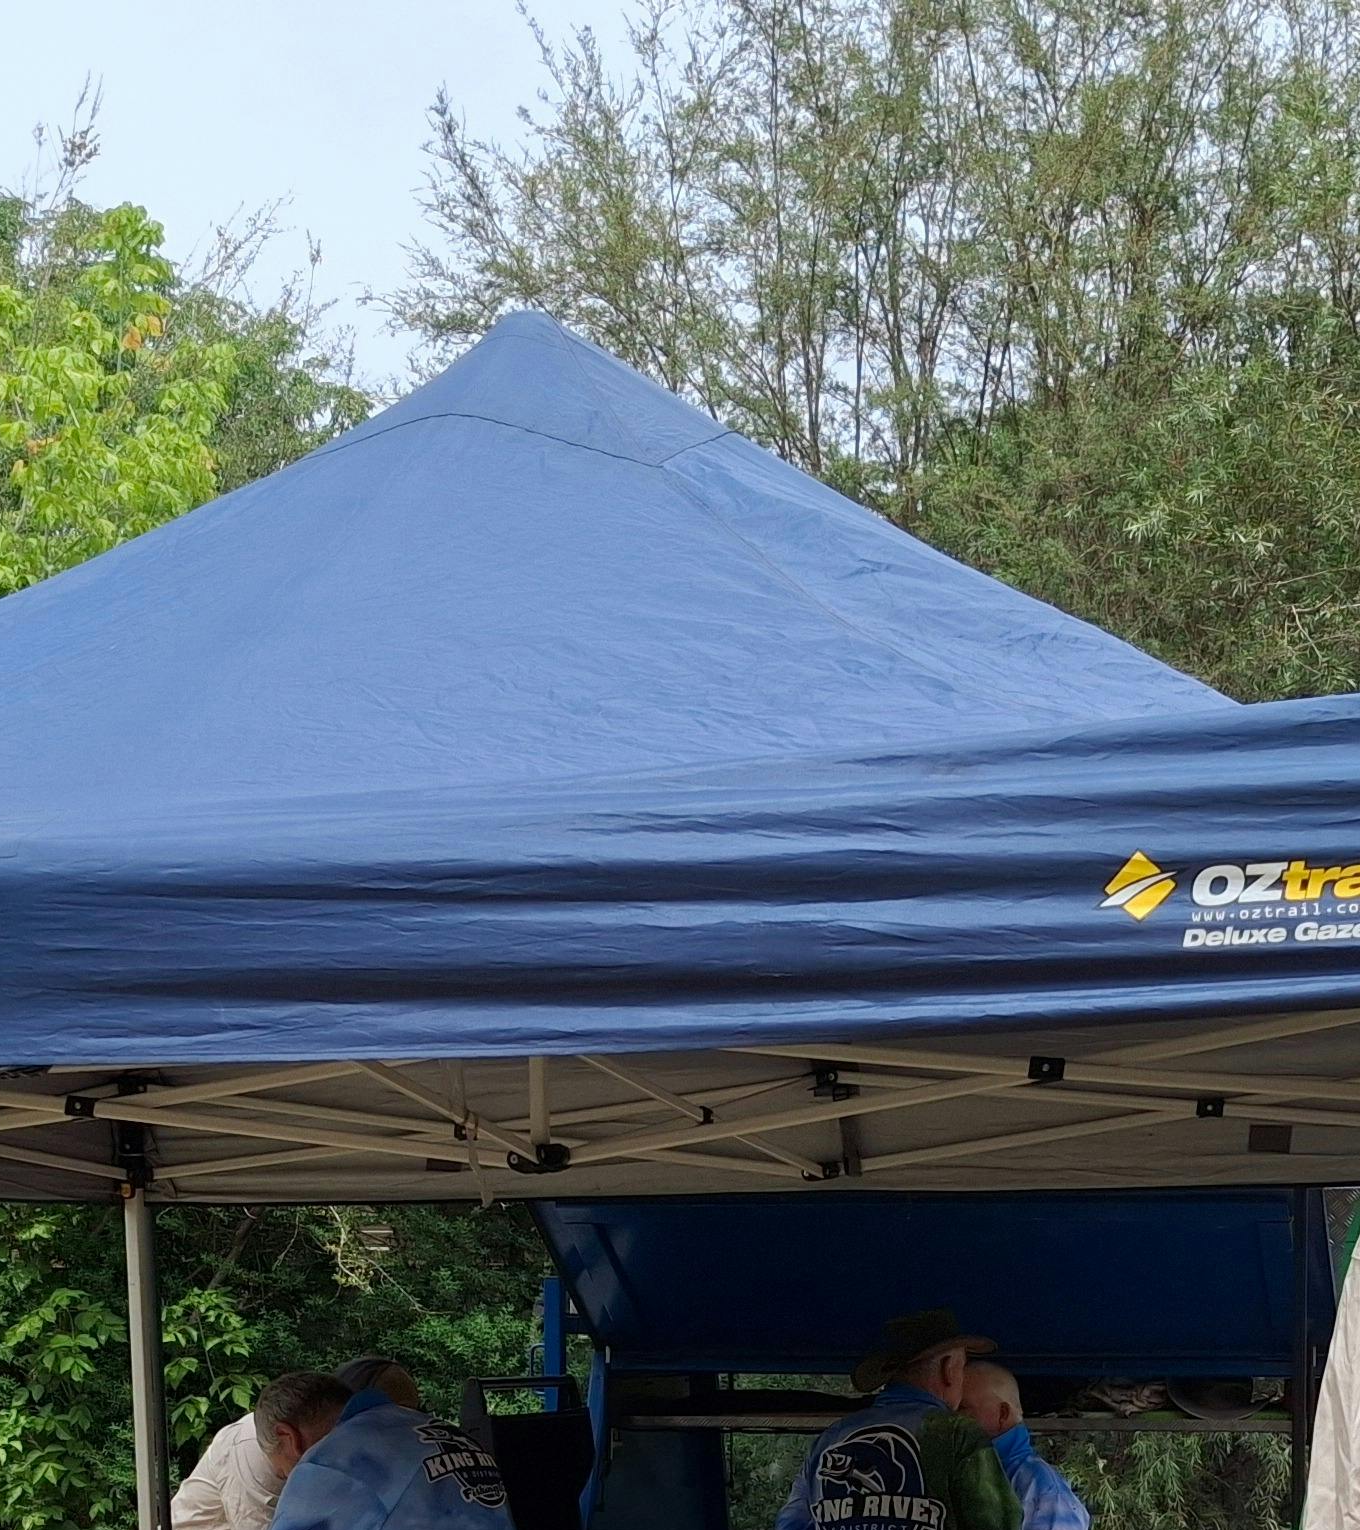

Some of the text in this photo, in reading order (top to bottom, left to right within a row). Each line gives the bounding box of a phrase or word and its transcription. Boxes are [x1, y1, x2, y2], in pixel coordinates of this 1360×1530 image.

[1183, 926, 1287, 948] Deluxe
[426, 1452, 475, 1478] KING
[816, 1494, 940, 1525] ING RIVER
